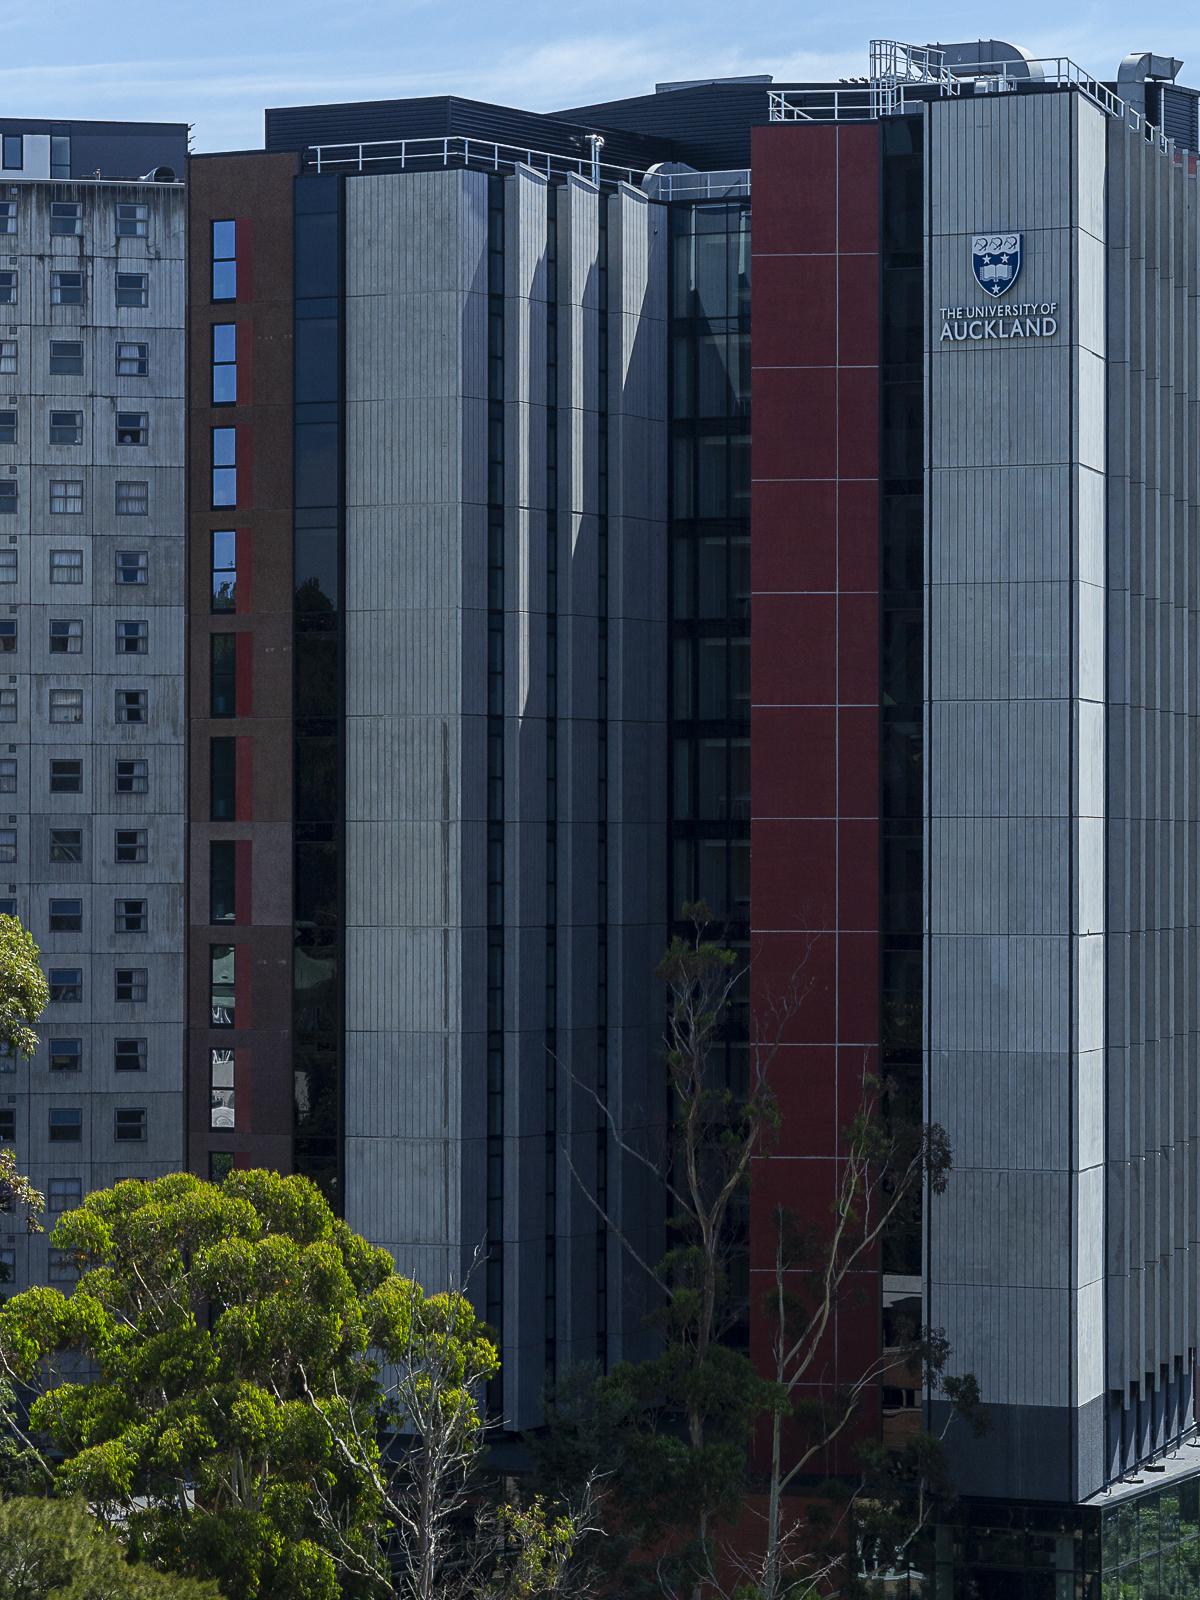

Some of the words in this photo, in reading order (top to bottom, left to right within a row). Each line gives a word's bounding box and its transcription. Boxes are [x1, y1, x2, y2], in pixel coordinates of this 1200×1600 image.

[940, 307, 963, 319] THE
[966, 303, 1038, 318] UNIVERSITY
[1040, 303, 1057, 315] OF
[940, 318, 1057, 341] AUCKLAND
